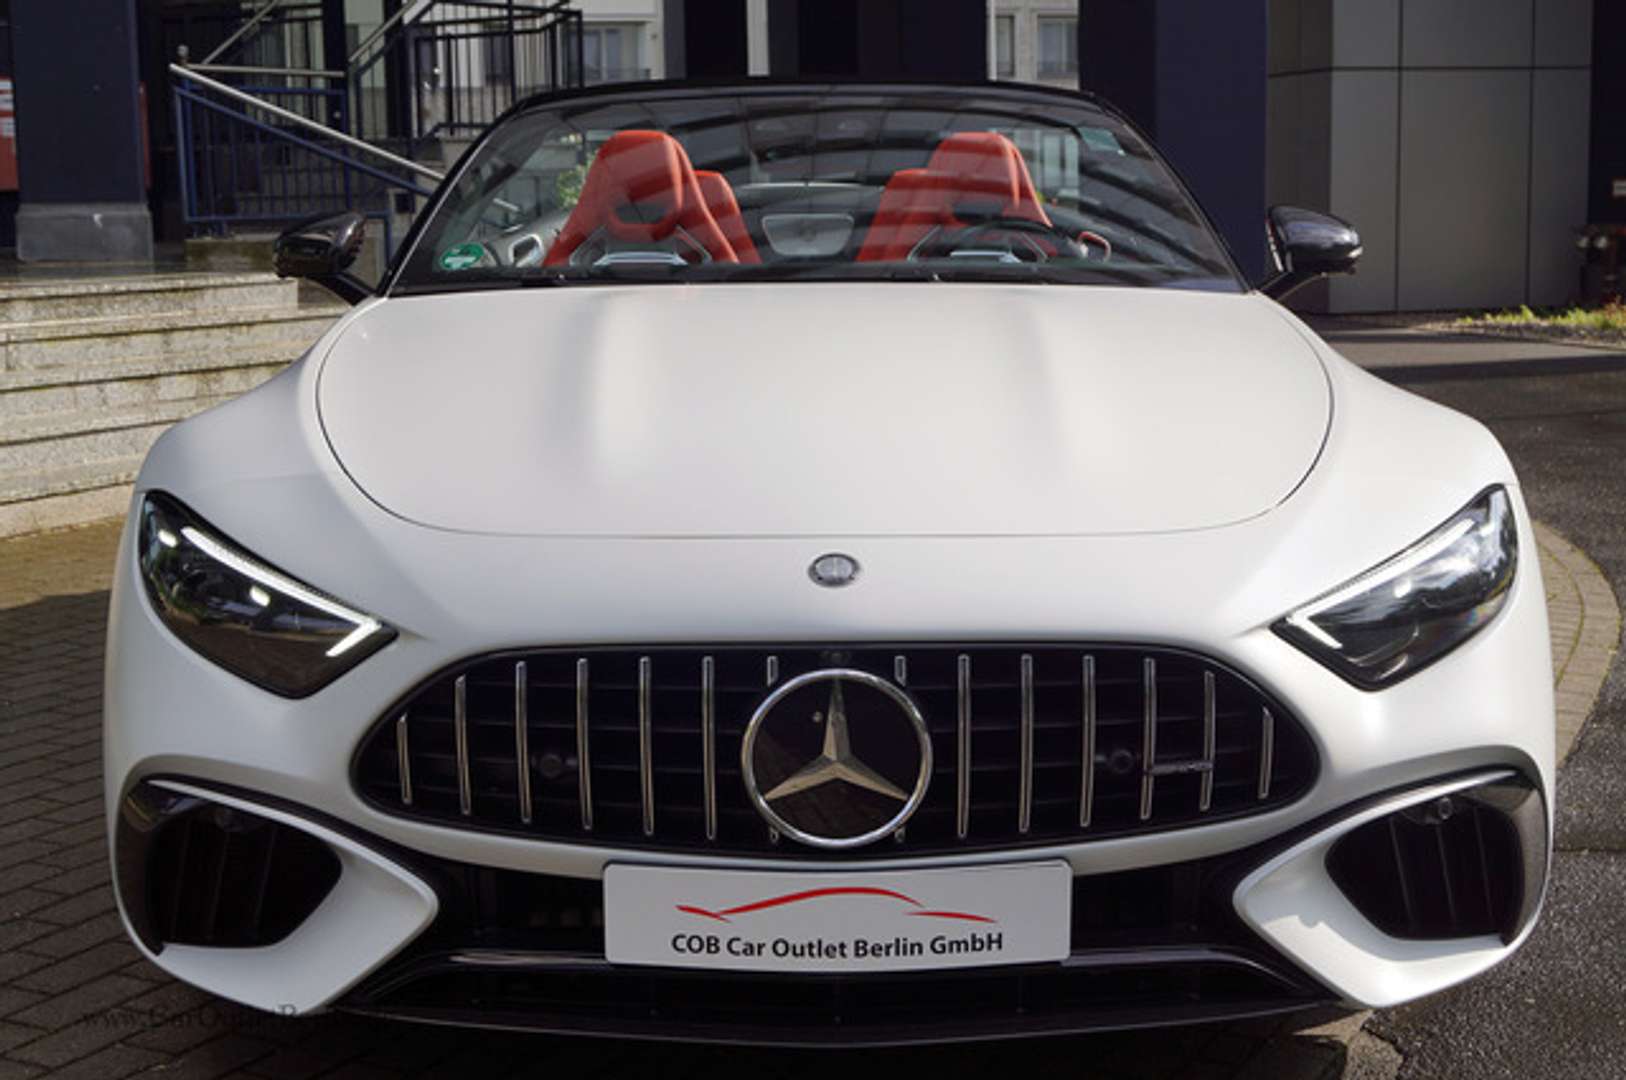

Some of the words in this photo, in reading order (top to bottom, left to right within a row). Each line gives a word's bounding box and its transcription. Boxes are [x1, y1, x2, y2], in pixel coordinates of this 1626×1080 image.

[671, 933, 721, 955] COB
[726, 936, 766, 957] Car
[772, 937, 848, 960] Outlet
[853, 937, 924, 958] Berlin
[929, 931, 1003, 955] GmbH
